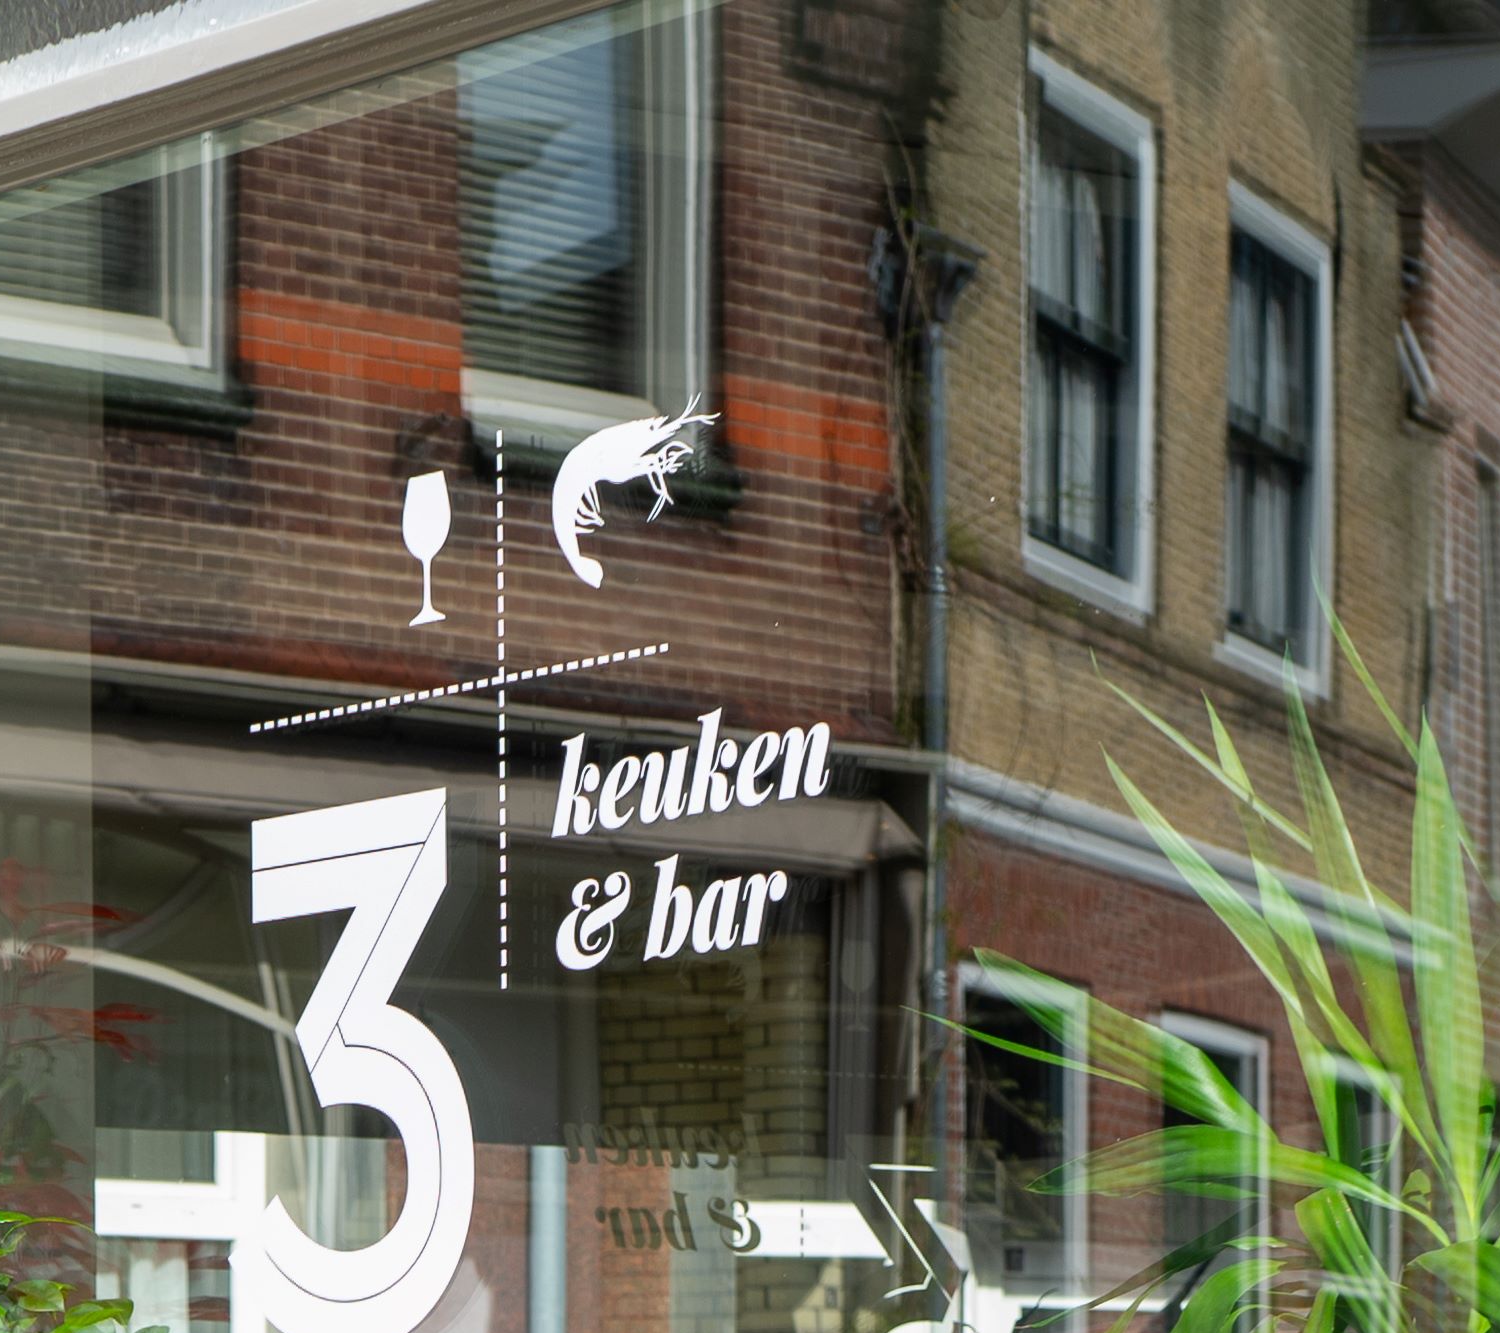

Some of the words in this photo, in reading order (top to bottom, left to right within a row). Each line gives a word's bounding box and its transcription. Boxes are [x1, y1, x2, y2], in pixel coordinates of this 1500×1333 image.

[551, 707, 831, 837] keuken
[555, 871, 632, 971] &
[643, 853, 787, 961] bar
